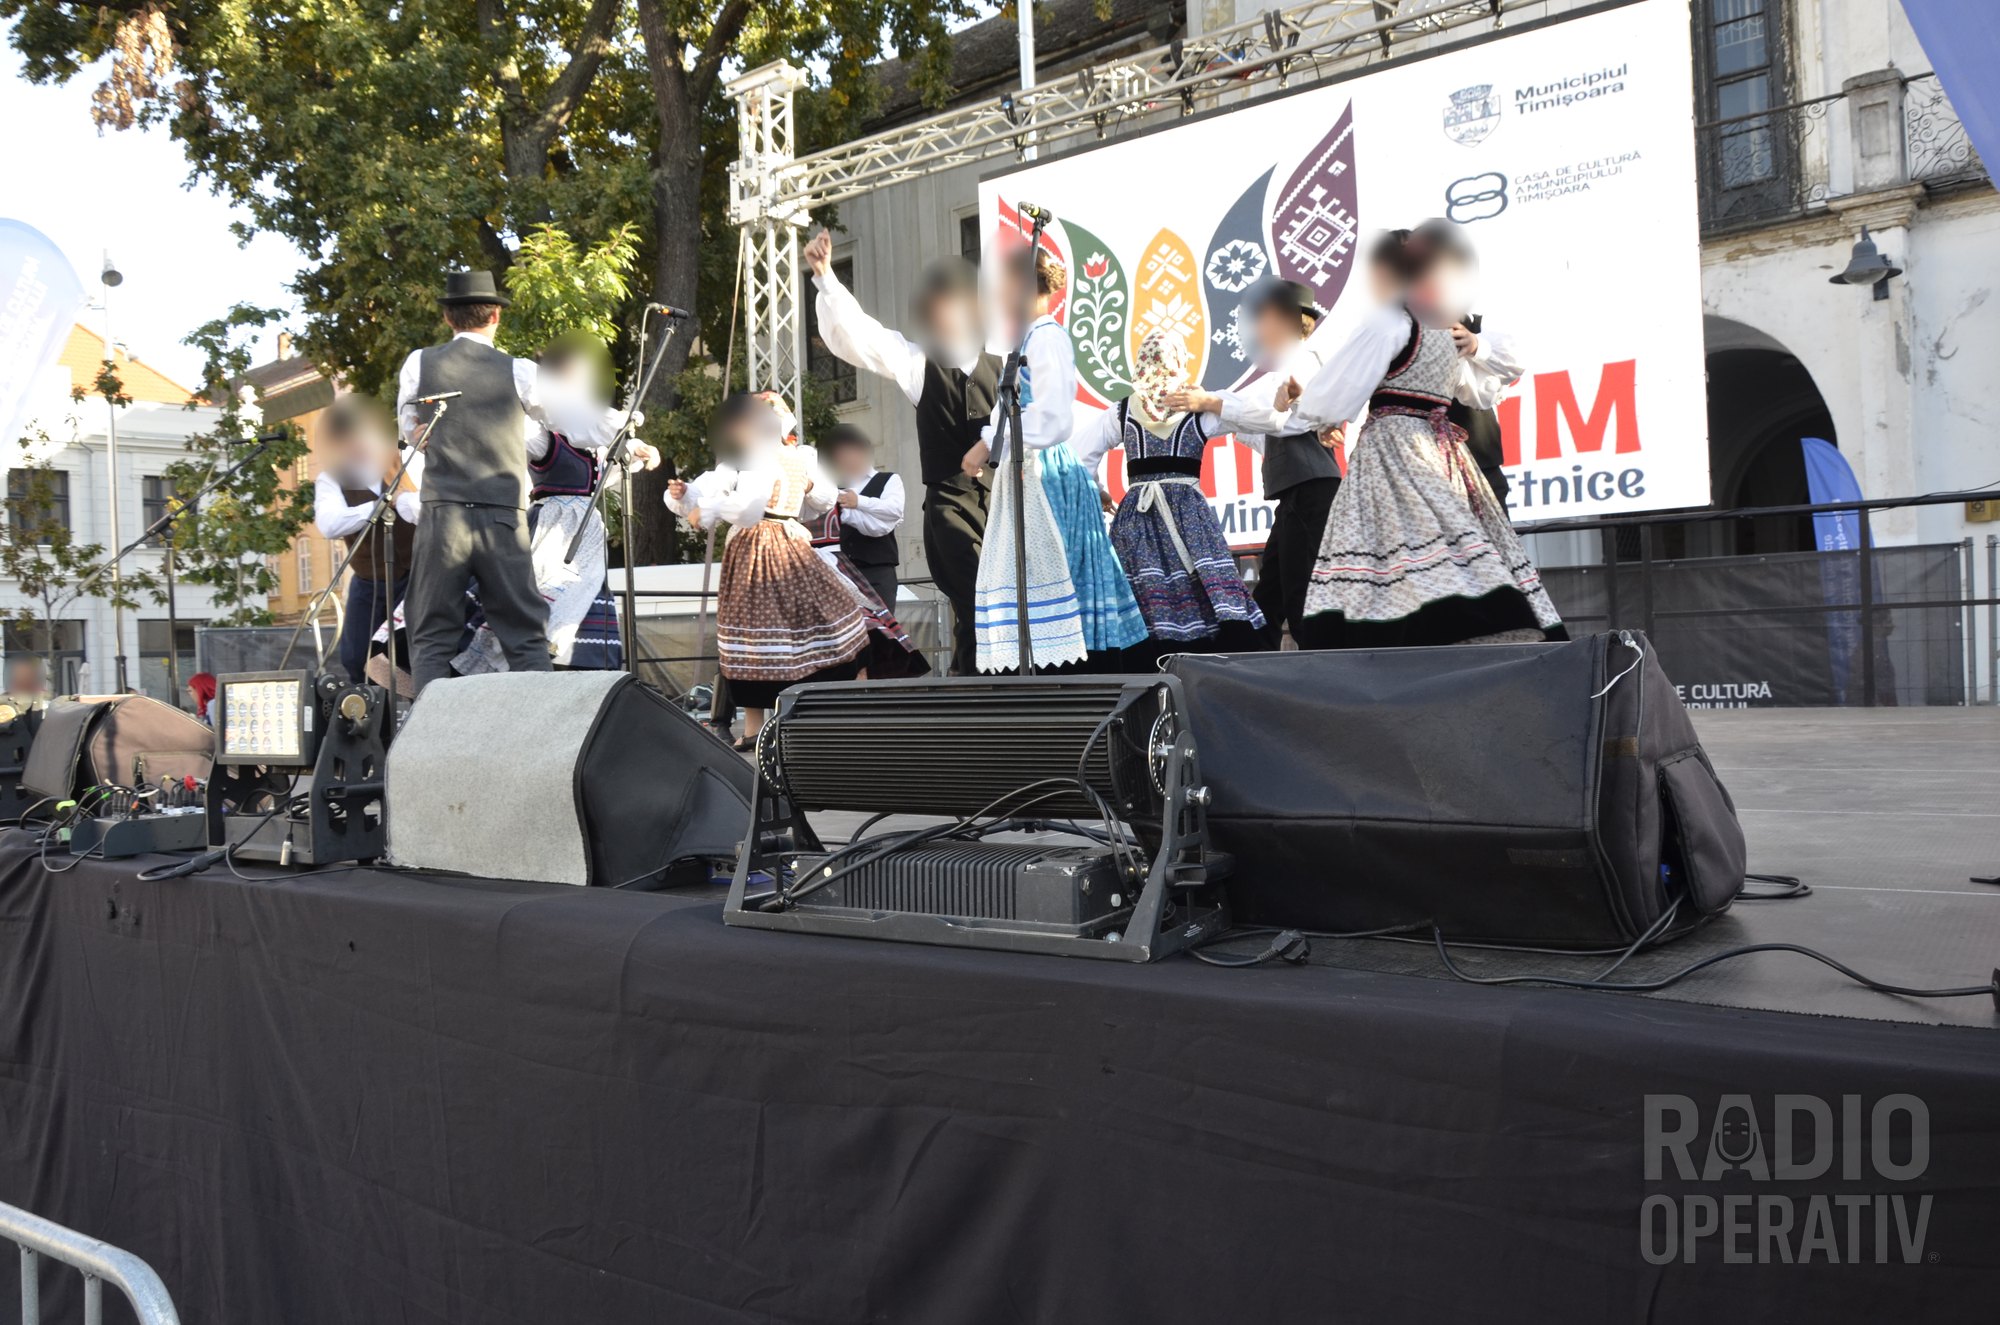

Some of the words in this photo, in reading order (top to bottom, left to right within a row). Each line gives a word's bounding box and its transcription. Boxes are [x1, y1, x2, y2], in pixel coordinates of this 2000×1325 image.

[1515, 63, 1628, 101] Municipiul
[1515, 81, 1624, 115] Timișoara
[1515, 170, 1550, 185] CASA
[1556, 165, 1572, 176] DE
[1577, 150, 1642, 172] CULTURĂ
[1515, 184, 1526, 195] A
[1527, 165, 1623, 193] MUNICIPIULUI
[1673, 685, 1686, 700] E
[1691, 681, 1772, 700] CULTURĂ
